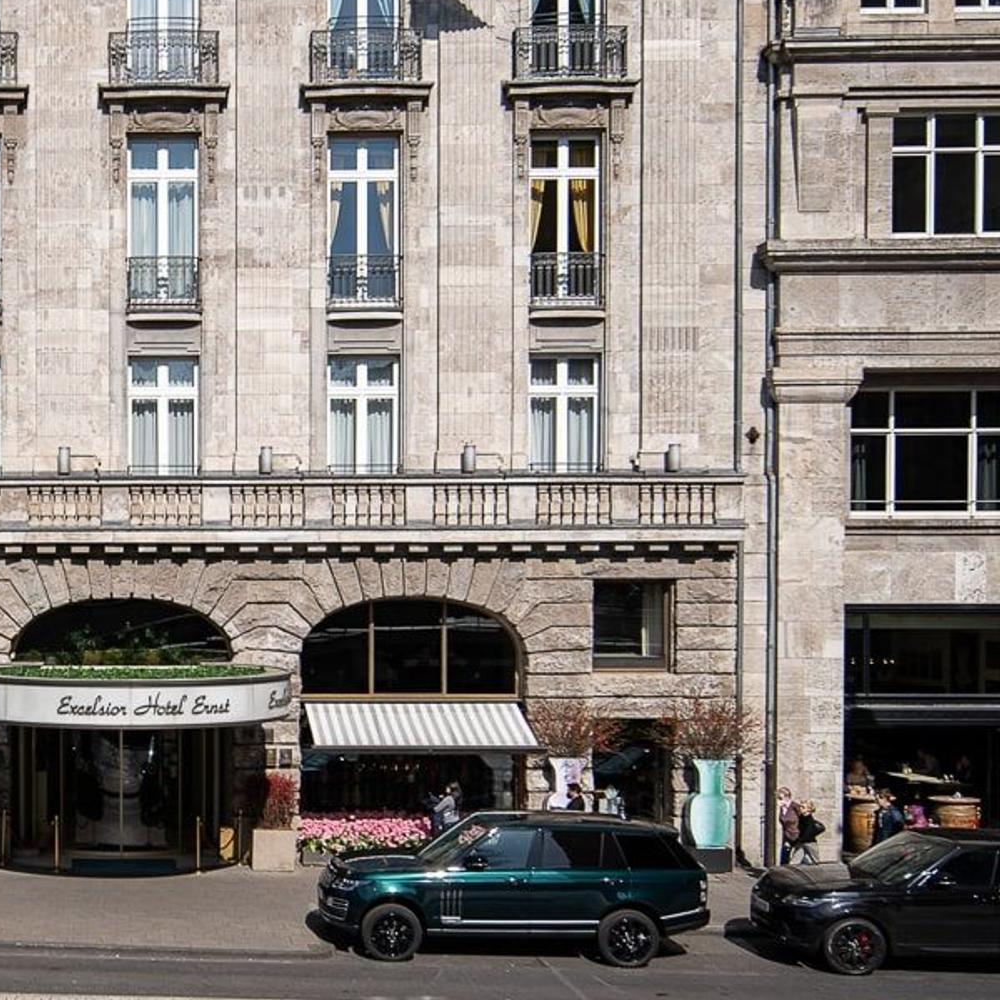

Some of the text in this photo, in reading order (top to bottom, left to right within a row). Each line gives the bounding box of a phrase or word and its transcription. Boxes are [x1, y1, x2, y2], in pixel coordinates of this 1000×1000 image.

[56, 691, 231, 716] Excelsior Hotel Ernst
